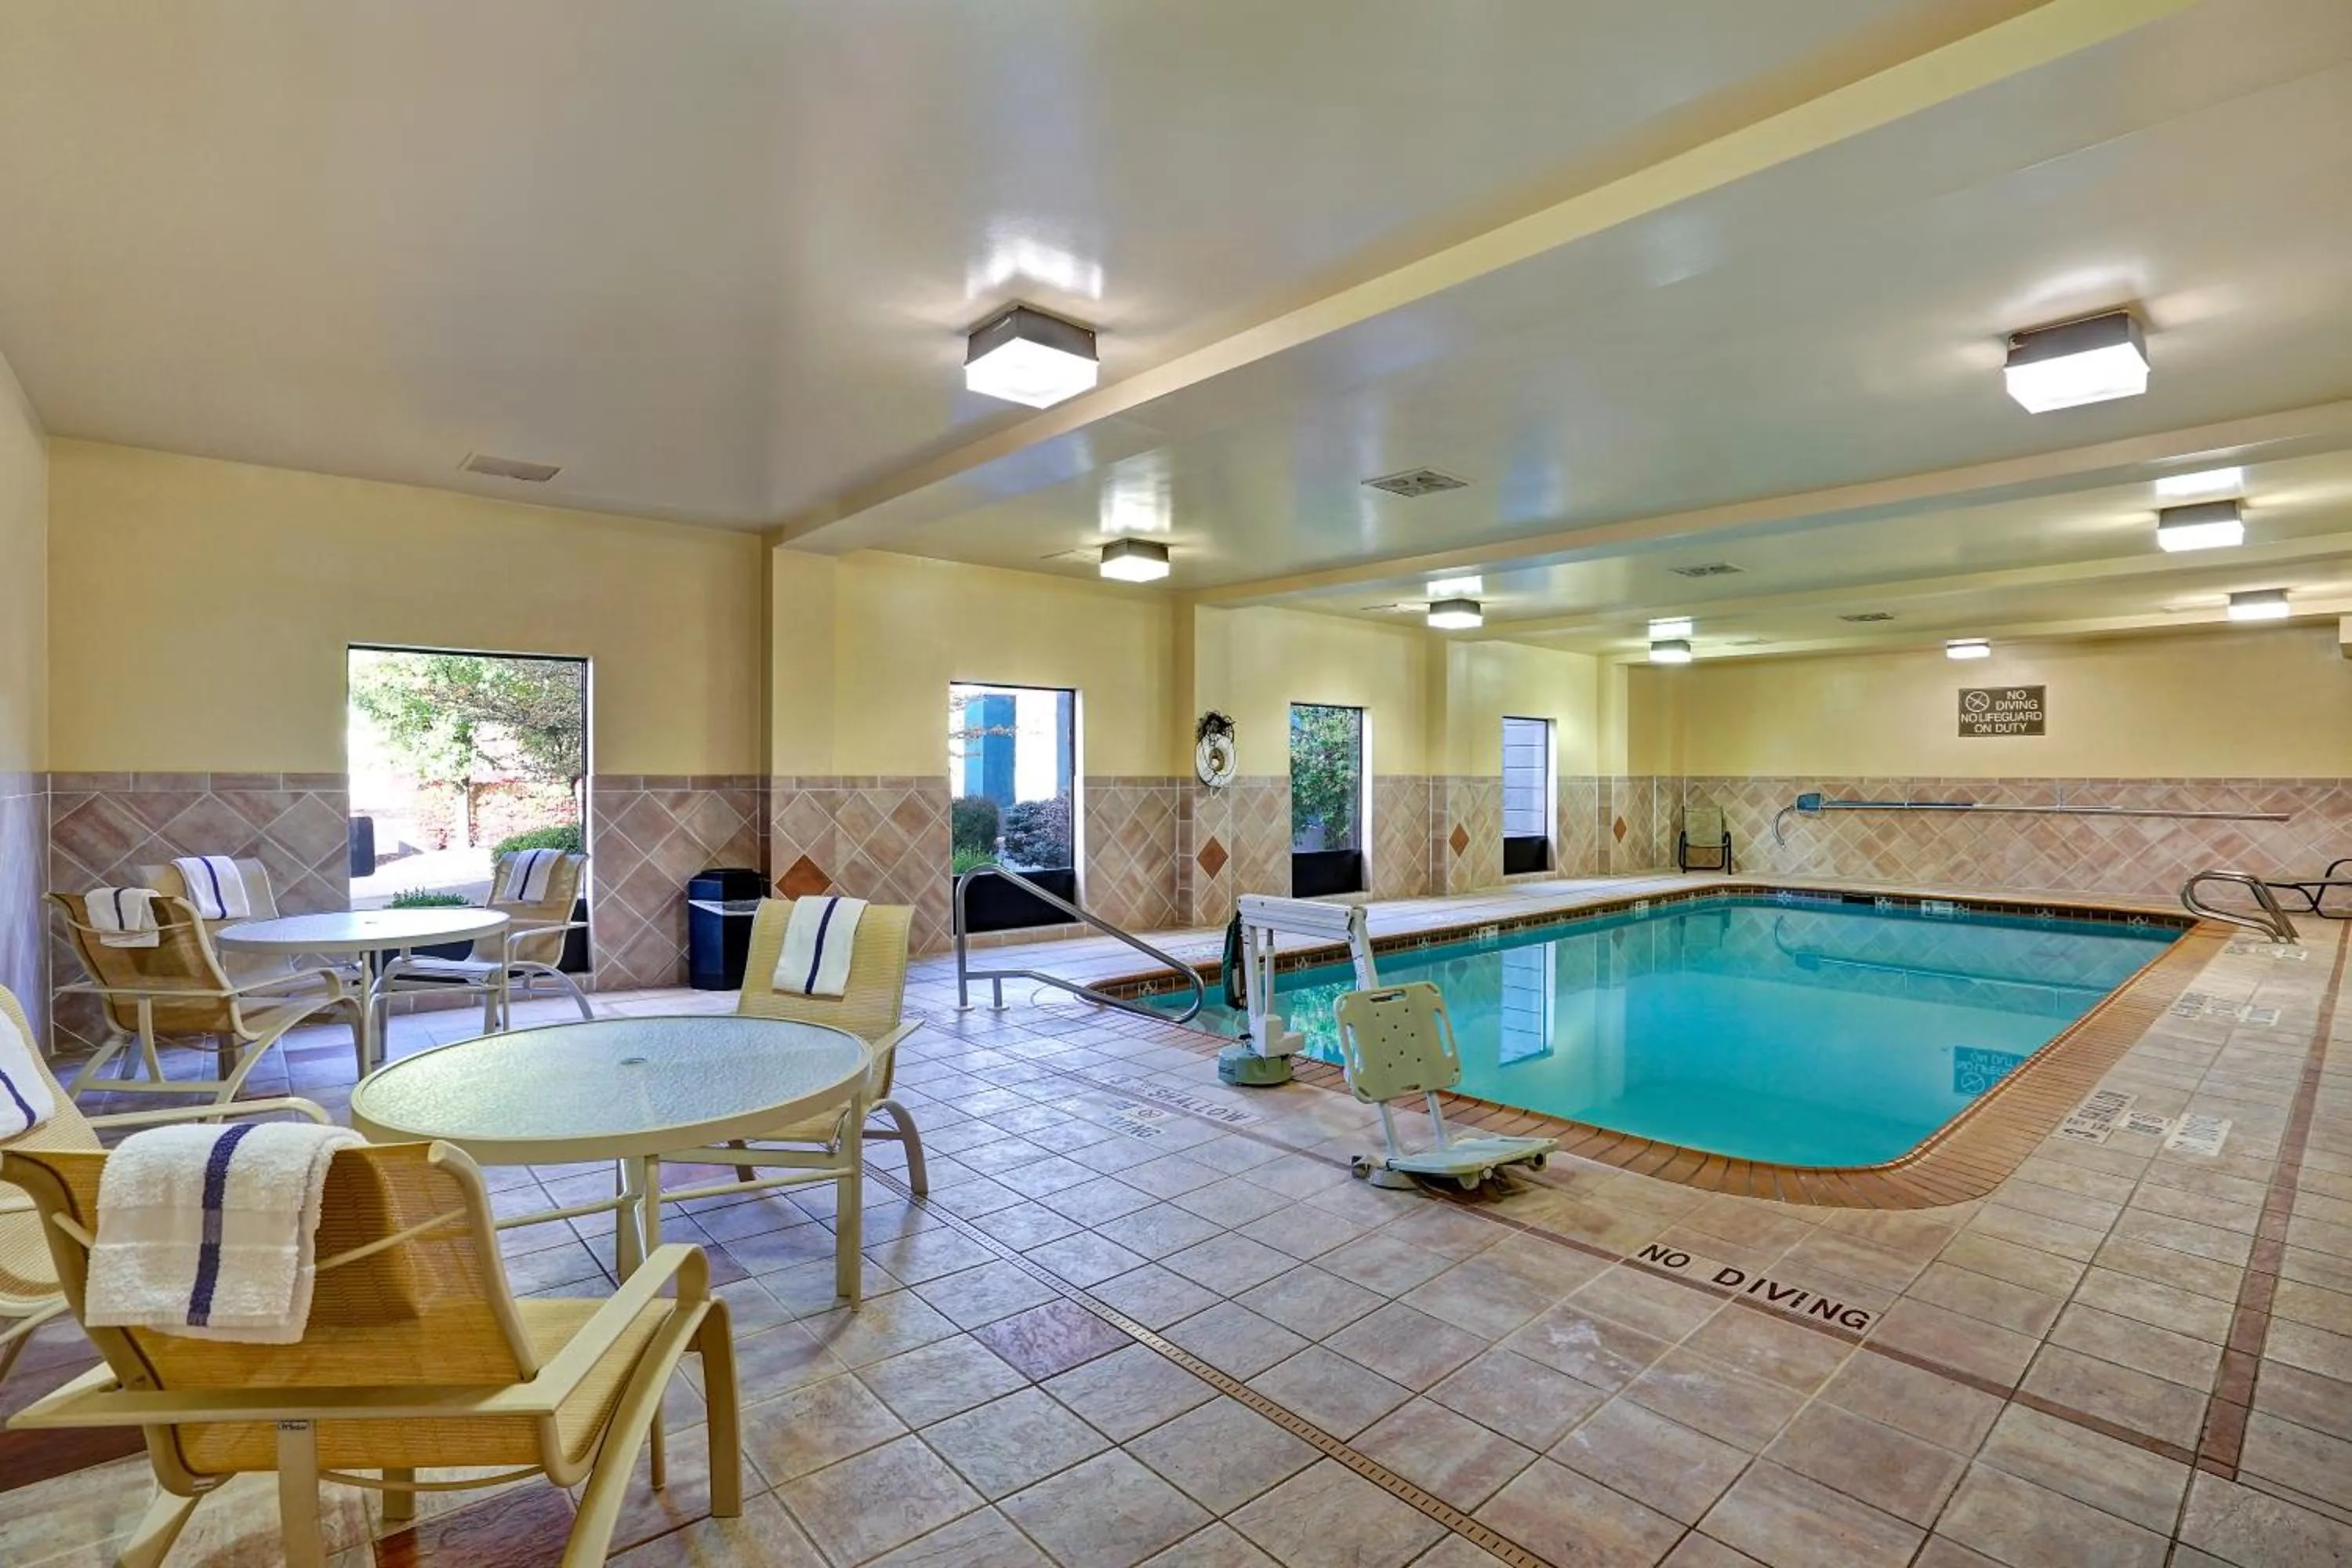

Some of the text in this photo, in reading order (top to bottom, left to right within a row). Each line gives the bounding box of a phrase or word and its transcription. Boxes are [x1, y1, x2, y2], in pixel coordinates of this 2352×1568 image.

[2007, 689, 2027, 700] NO
[1995, 699, 2038, 710] DIVING
[1961, 711, 2042, 723] NO LIFEGUARD
[1974, 722, 2027, 733] ON DUTY
[1148, 1088, 1248, 1122] SHALLOW
[1637, 1243, 1871, 1330] NO DIVING
